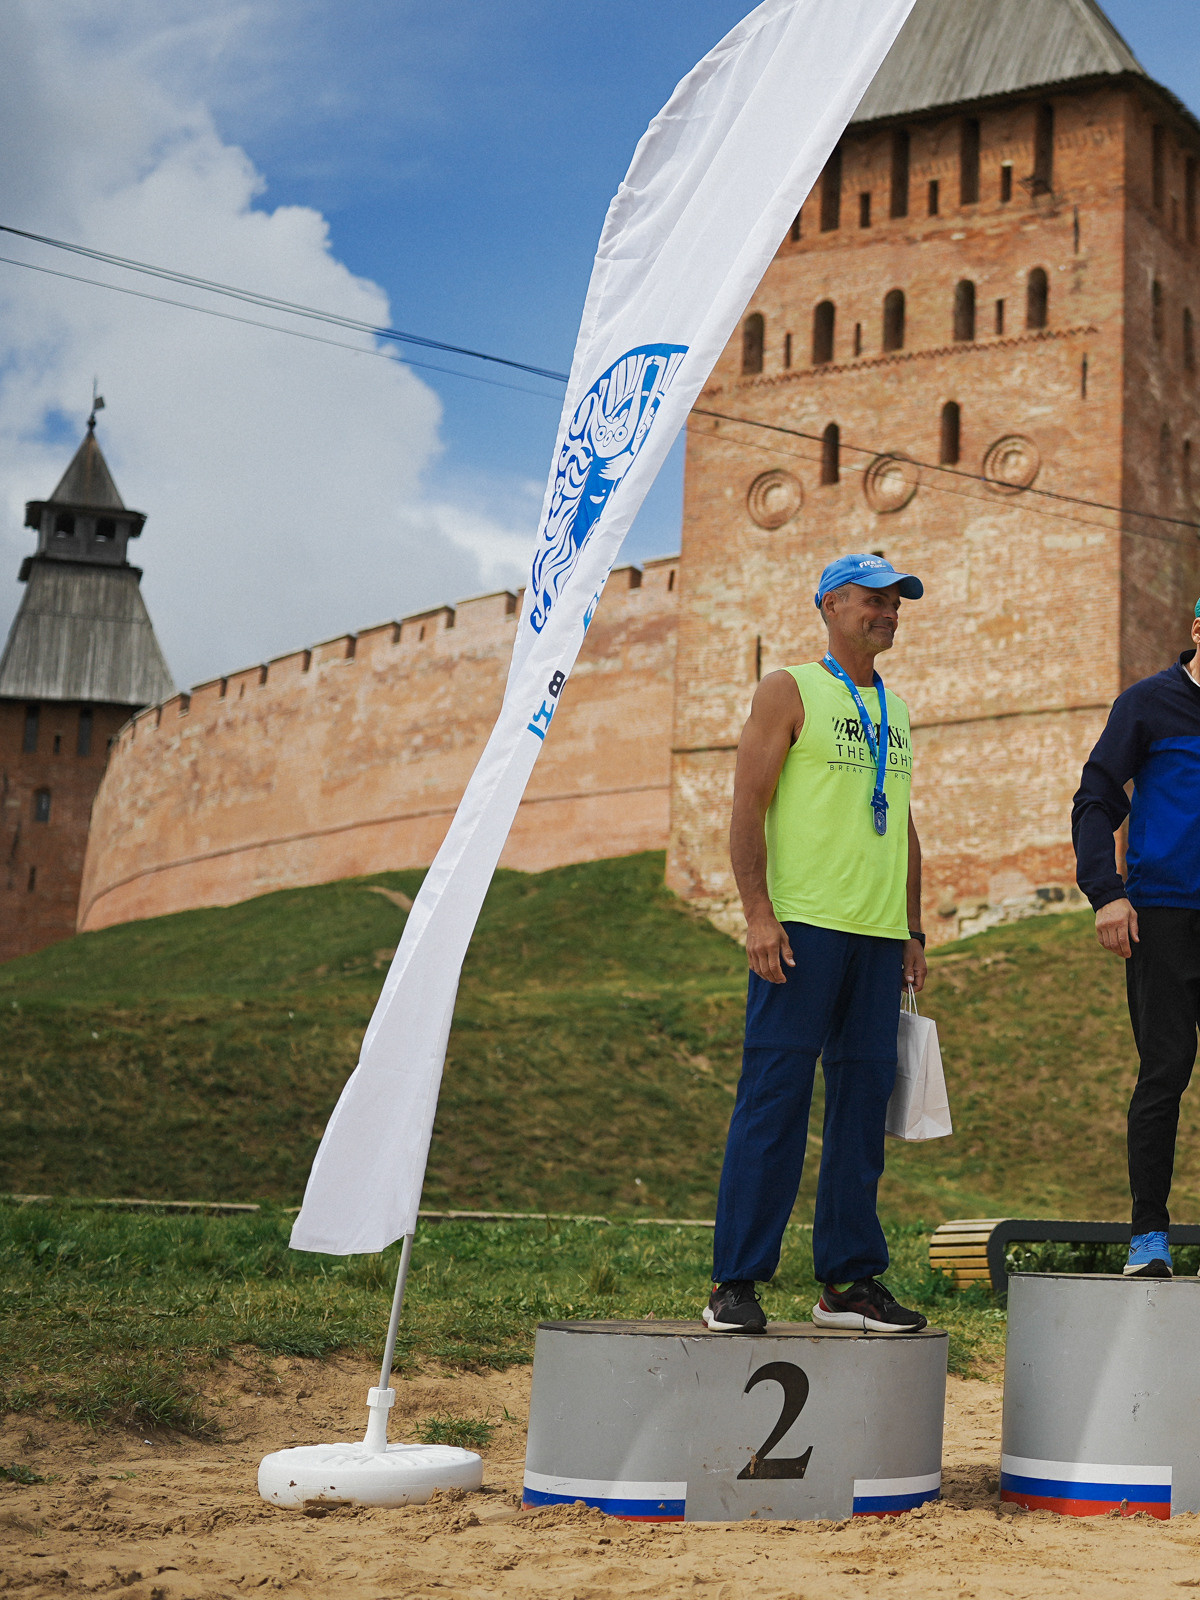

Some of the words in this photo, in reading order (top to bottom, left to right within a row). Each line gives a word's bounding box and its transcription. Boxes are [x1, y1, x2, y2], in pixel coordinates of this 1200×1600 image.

[858, 560, 876, 569] FIFA
[835, 743, 865, 761] THE
[829, 764, 863, 774] BREAK
[736, 1361, 813, 1480] 2
